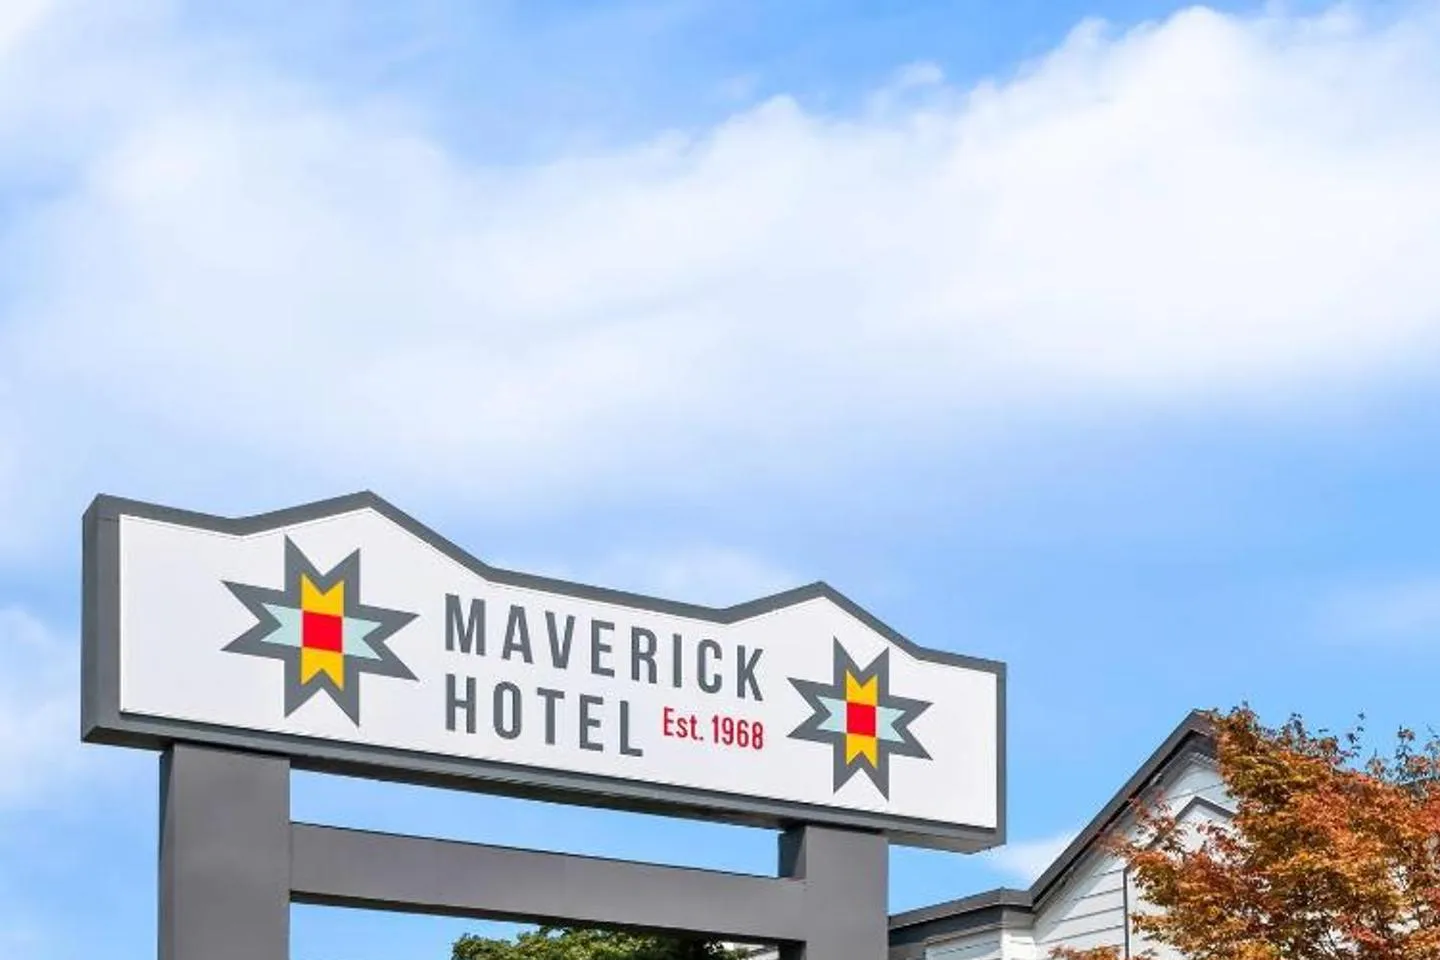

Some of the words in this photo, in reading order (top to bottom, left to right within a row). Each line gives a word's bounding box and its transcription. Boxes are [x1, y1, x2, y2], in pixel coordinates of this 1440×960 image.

[445, 593, 764, 702] MAVERICK
[445, 673, 644, 758] HOTEL
[663, 706, 704, 741] Est.
[711, 714, 764, 750] 1968
